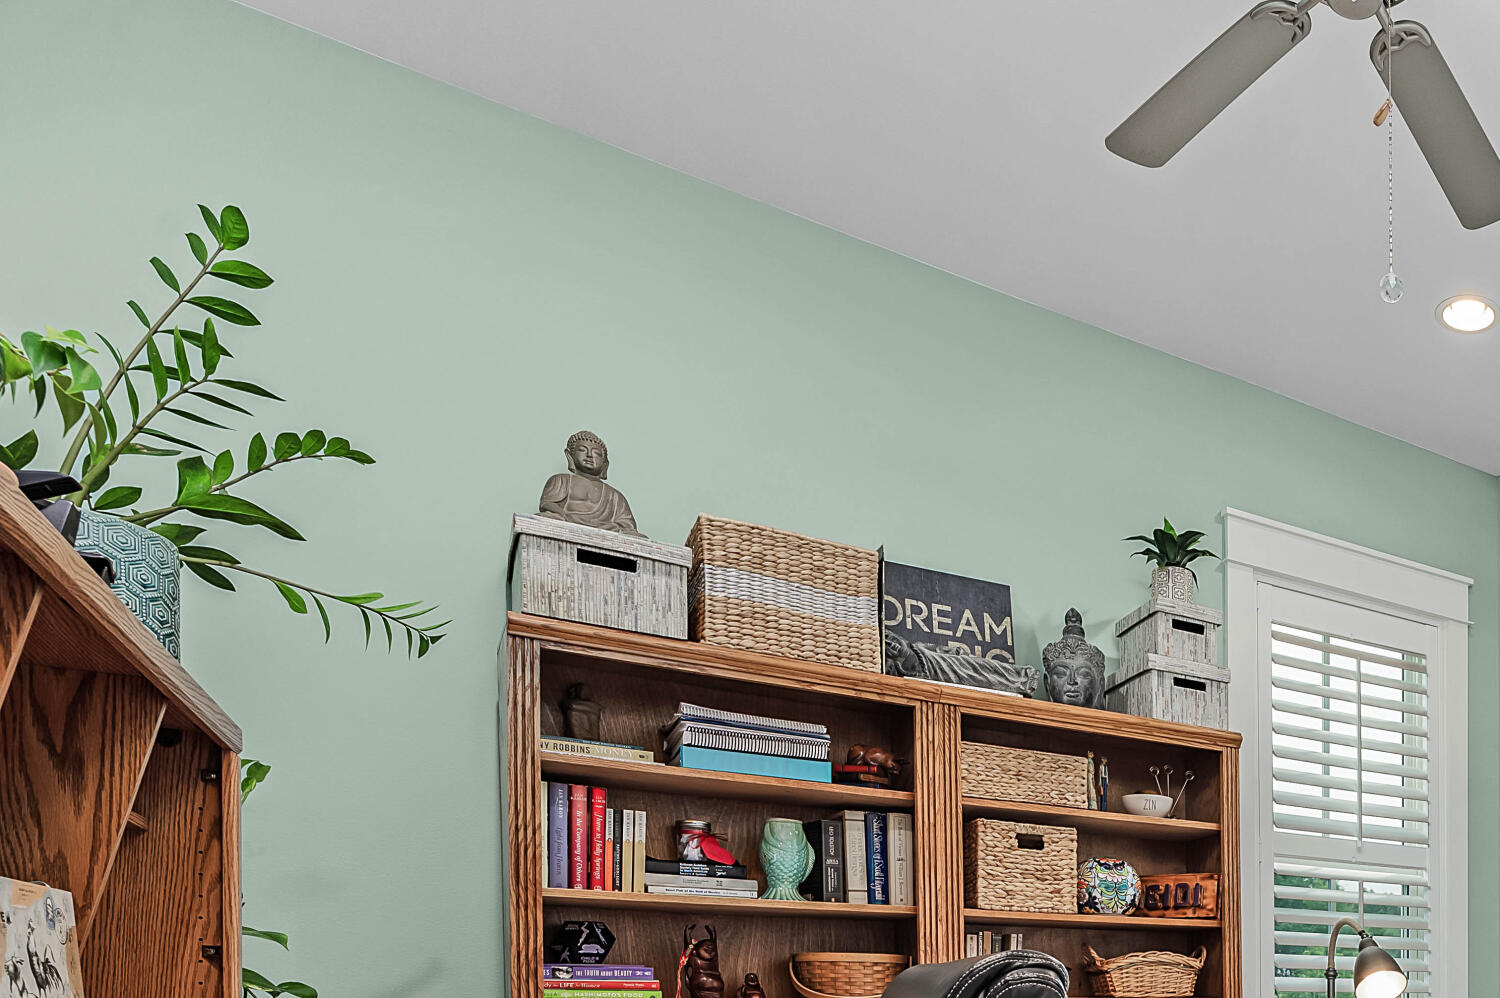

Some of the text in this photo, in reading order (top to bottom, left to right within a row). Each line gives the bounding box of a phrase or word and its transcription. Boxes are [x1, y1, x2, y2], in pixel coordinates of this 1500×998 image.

[884, 594, 1013, 646] DREAM
[553, 743, 591, 754] ROBBINS
[574, 828, 583, 854] Company
